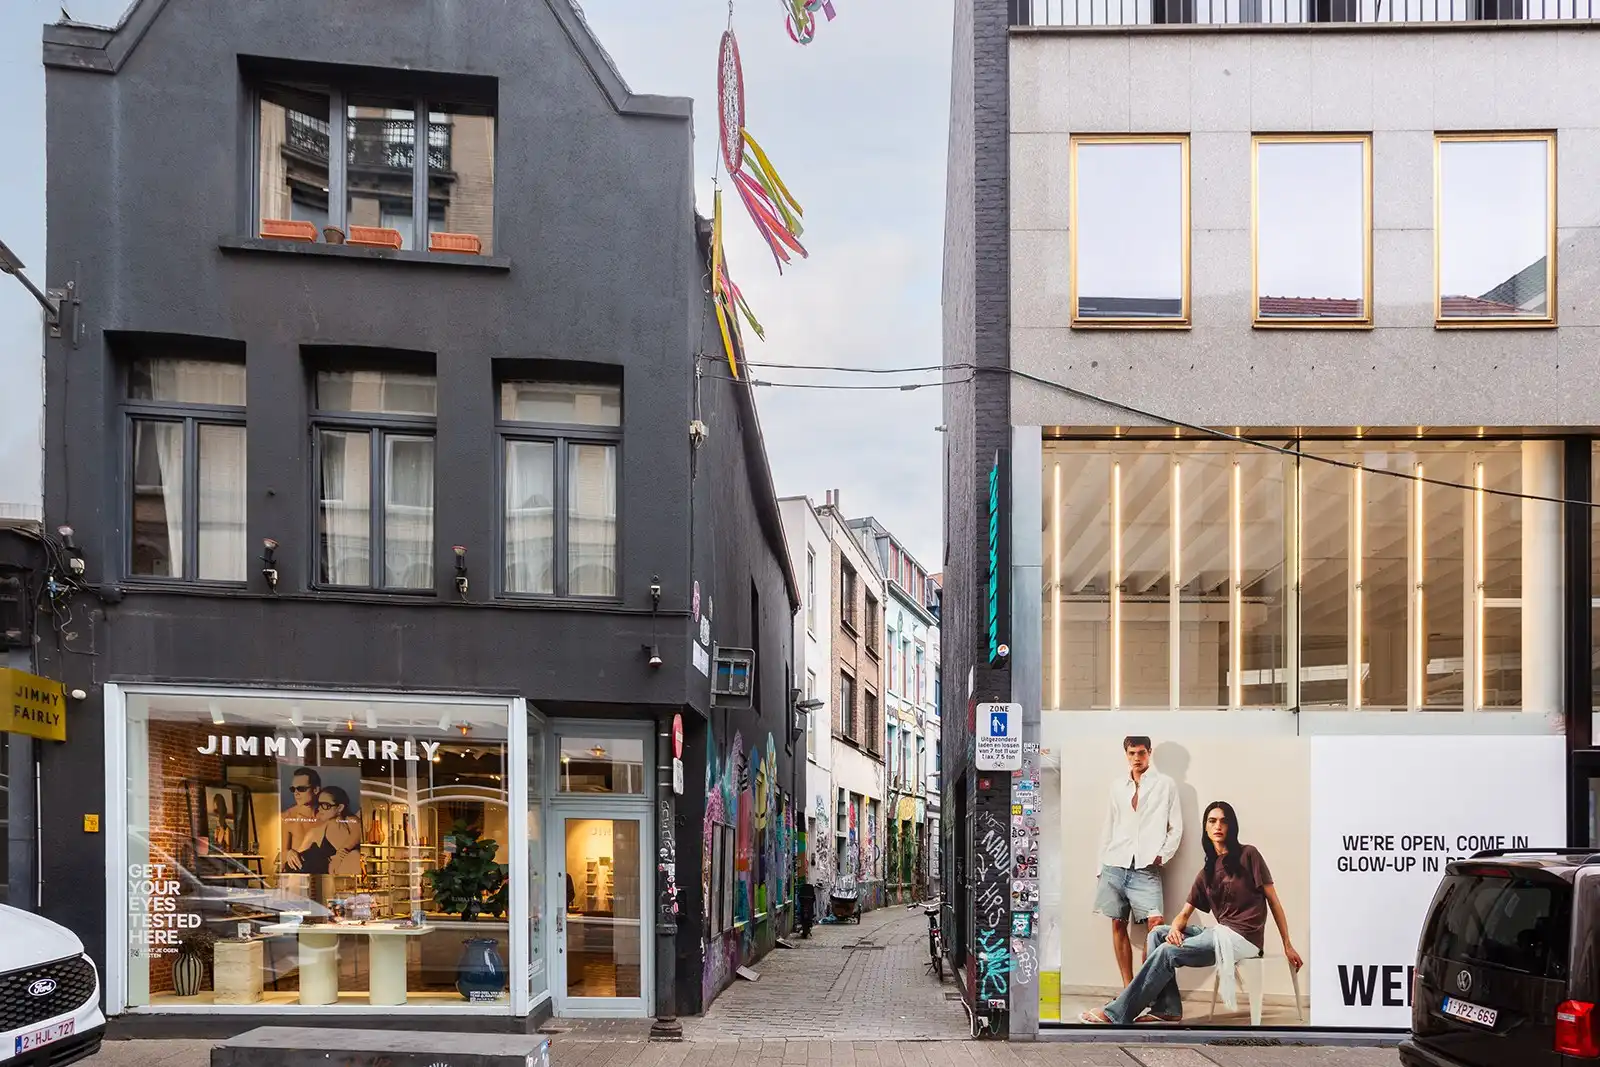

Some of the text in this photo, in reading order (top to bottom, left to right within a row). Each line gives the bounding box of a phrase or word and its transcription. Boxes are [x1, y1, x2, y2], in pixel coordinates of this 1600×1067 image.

[15, 686, 59, 706] JIMMY
[14, 705, 60, 726] FAIRLY
[197, 734, 440, 761] JIMMY FAIRLY
[1343, 836, 1528, 853] WE’RE OPEN, COME IN
[129, 864, 166, 878] GET
[1337, 856, 1416, 872] GLOW-UP
[1423, 857, 1438, 872] IN
[129, 881, 180, 895] YOUR
[129, 897, 176, 911] EYES
[129, 914, 201, 928] TESTED
[129, 930, 183, 944] HERE.
[34, 981, 52, 994] Ford
